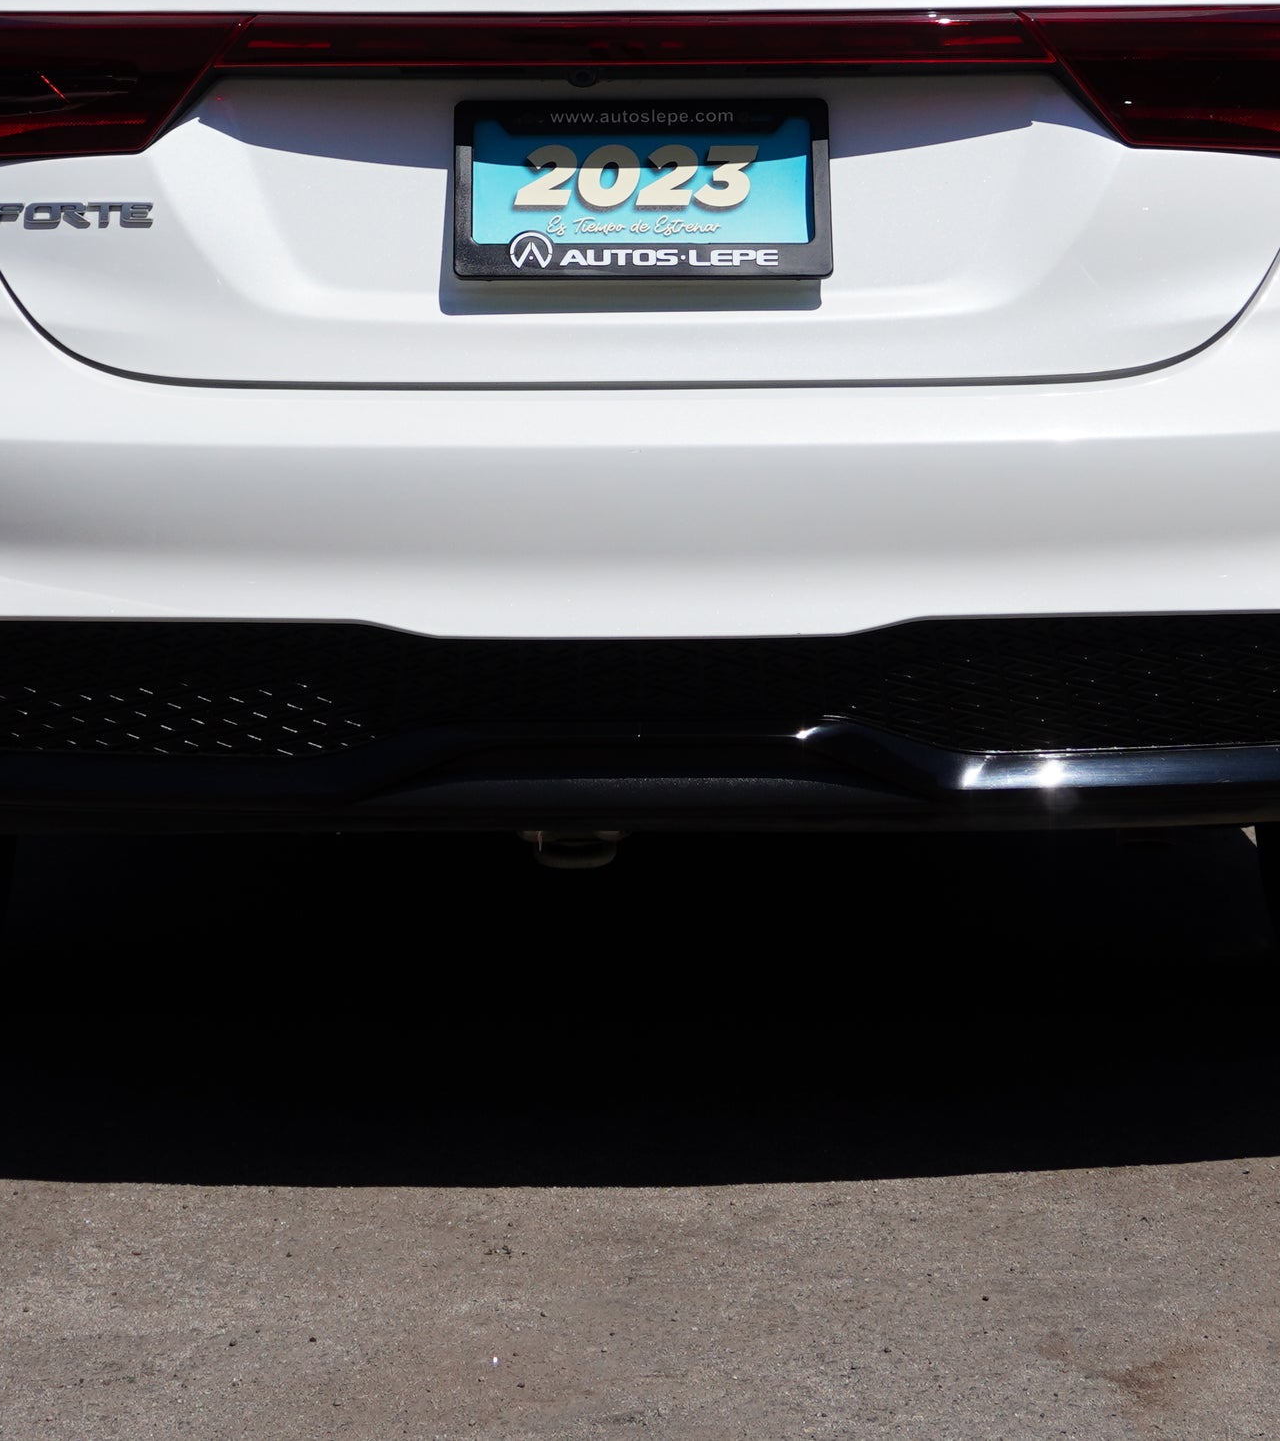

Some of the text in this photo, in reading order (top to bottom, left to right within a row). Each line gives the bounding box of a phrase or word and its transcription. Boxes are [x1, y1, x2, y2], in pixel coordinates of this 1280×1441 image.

[550, 109, 734, 126] www.autoslepe.com
[513, 144, 760, 211] 2023
[547, 215, 722, 236] Es Tiempo de Estrenar
